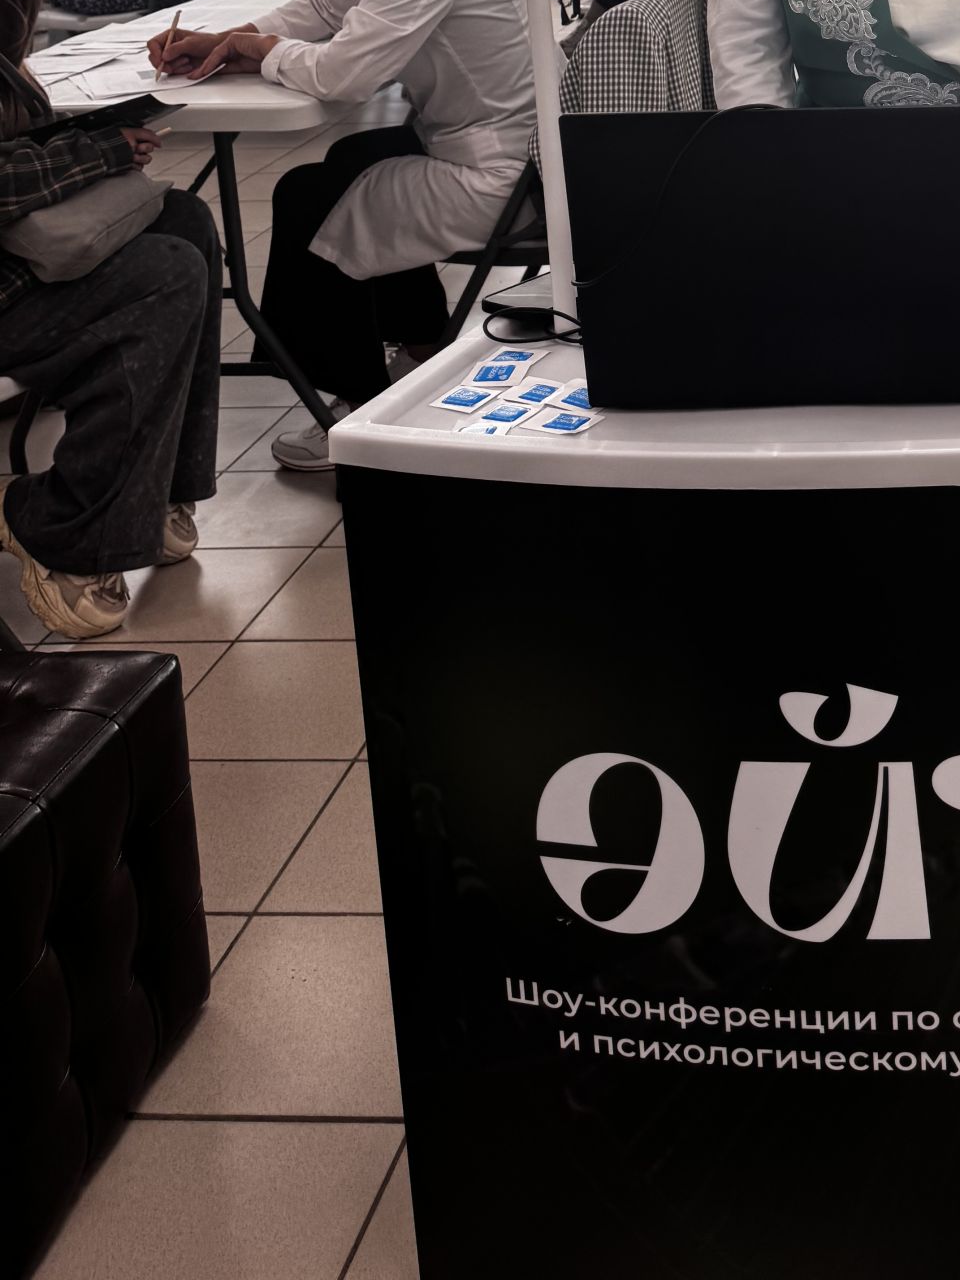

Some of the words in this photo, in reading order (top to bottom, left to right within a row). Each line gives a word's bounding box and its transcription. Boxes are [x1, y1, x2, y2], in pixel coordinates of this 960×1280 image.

[506, 977, 877, 1034] Шоу-конференции
[892, 1010, 941, 1031] по
[559, 1030, 580, 1051] и
